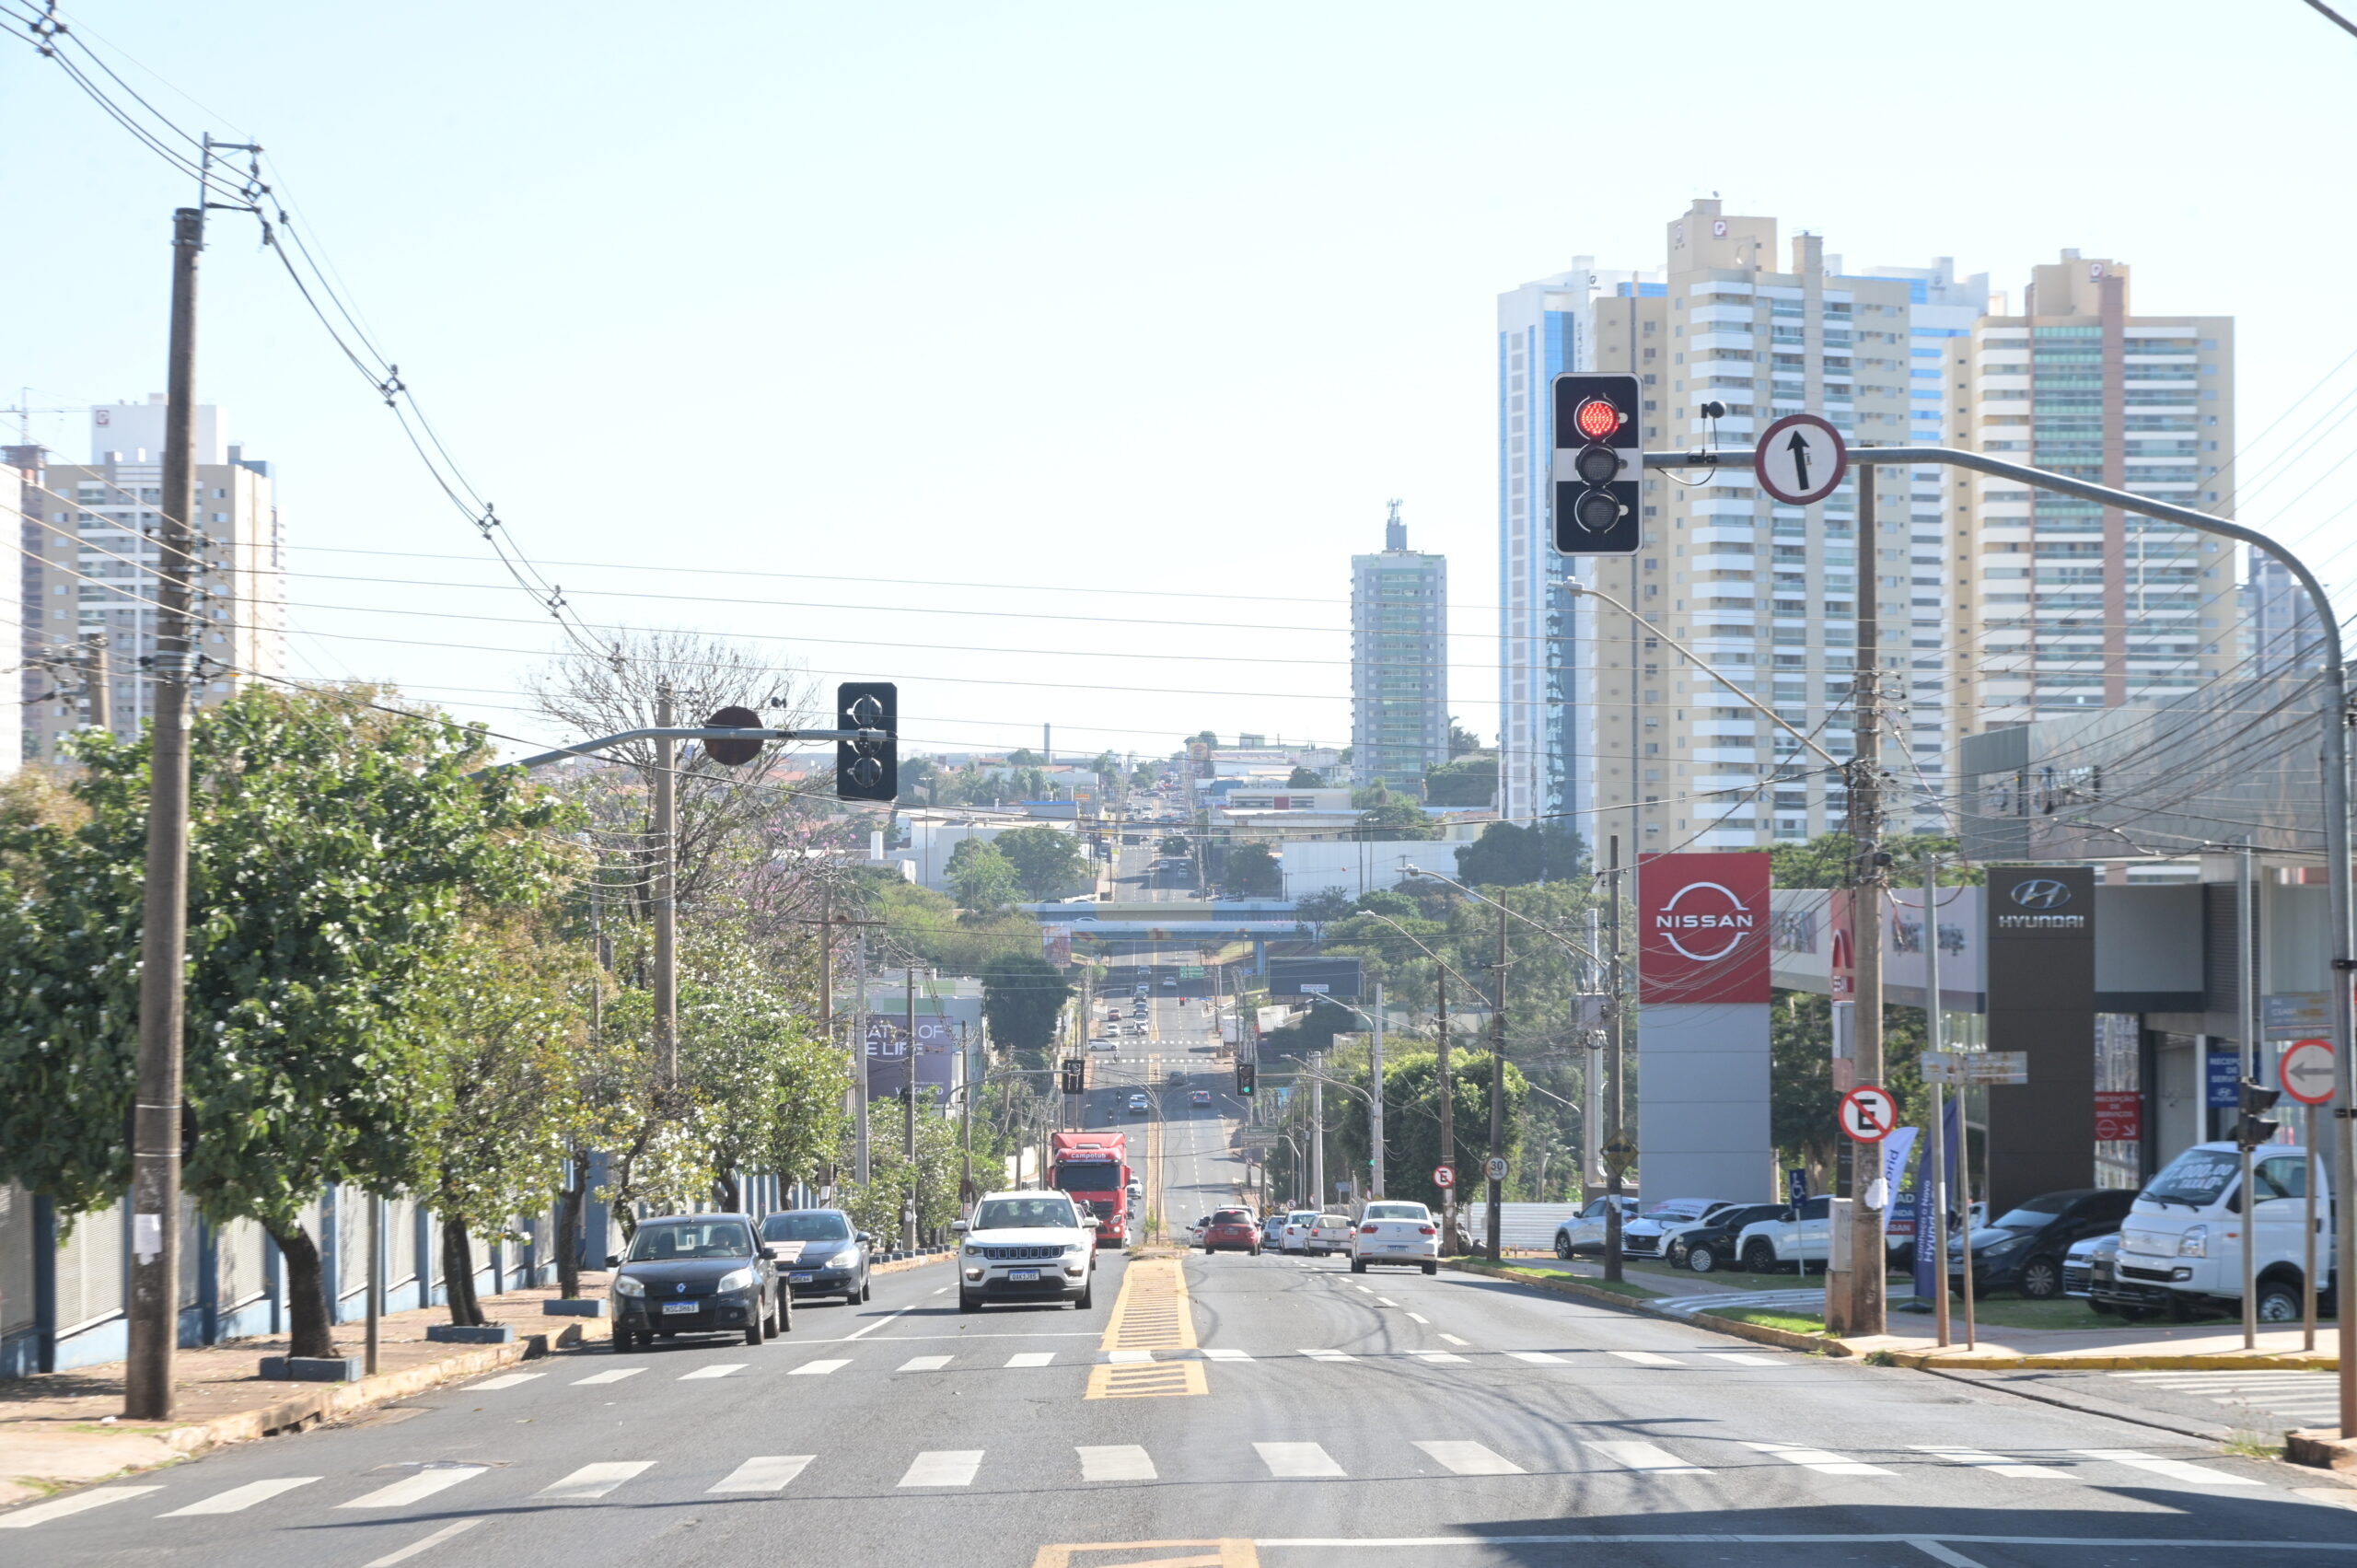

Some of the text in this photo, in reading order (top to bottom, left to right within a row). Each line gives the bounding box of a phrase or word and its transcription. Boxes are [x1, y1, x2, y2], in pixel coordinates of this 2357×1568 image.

[1655, 914, 1753, 928] NISSAN
[1999, 915, 2084, 928] HYUNDAI
[918, 1024, 945, 1039] OF
[1857, 1098, 1877, 1131] E
[1491, 1160, 1504, 1171] 30
